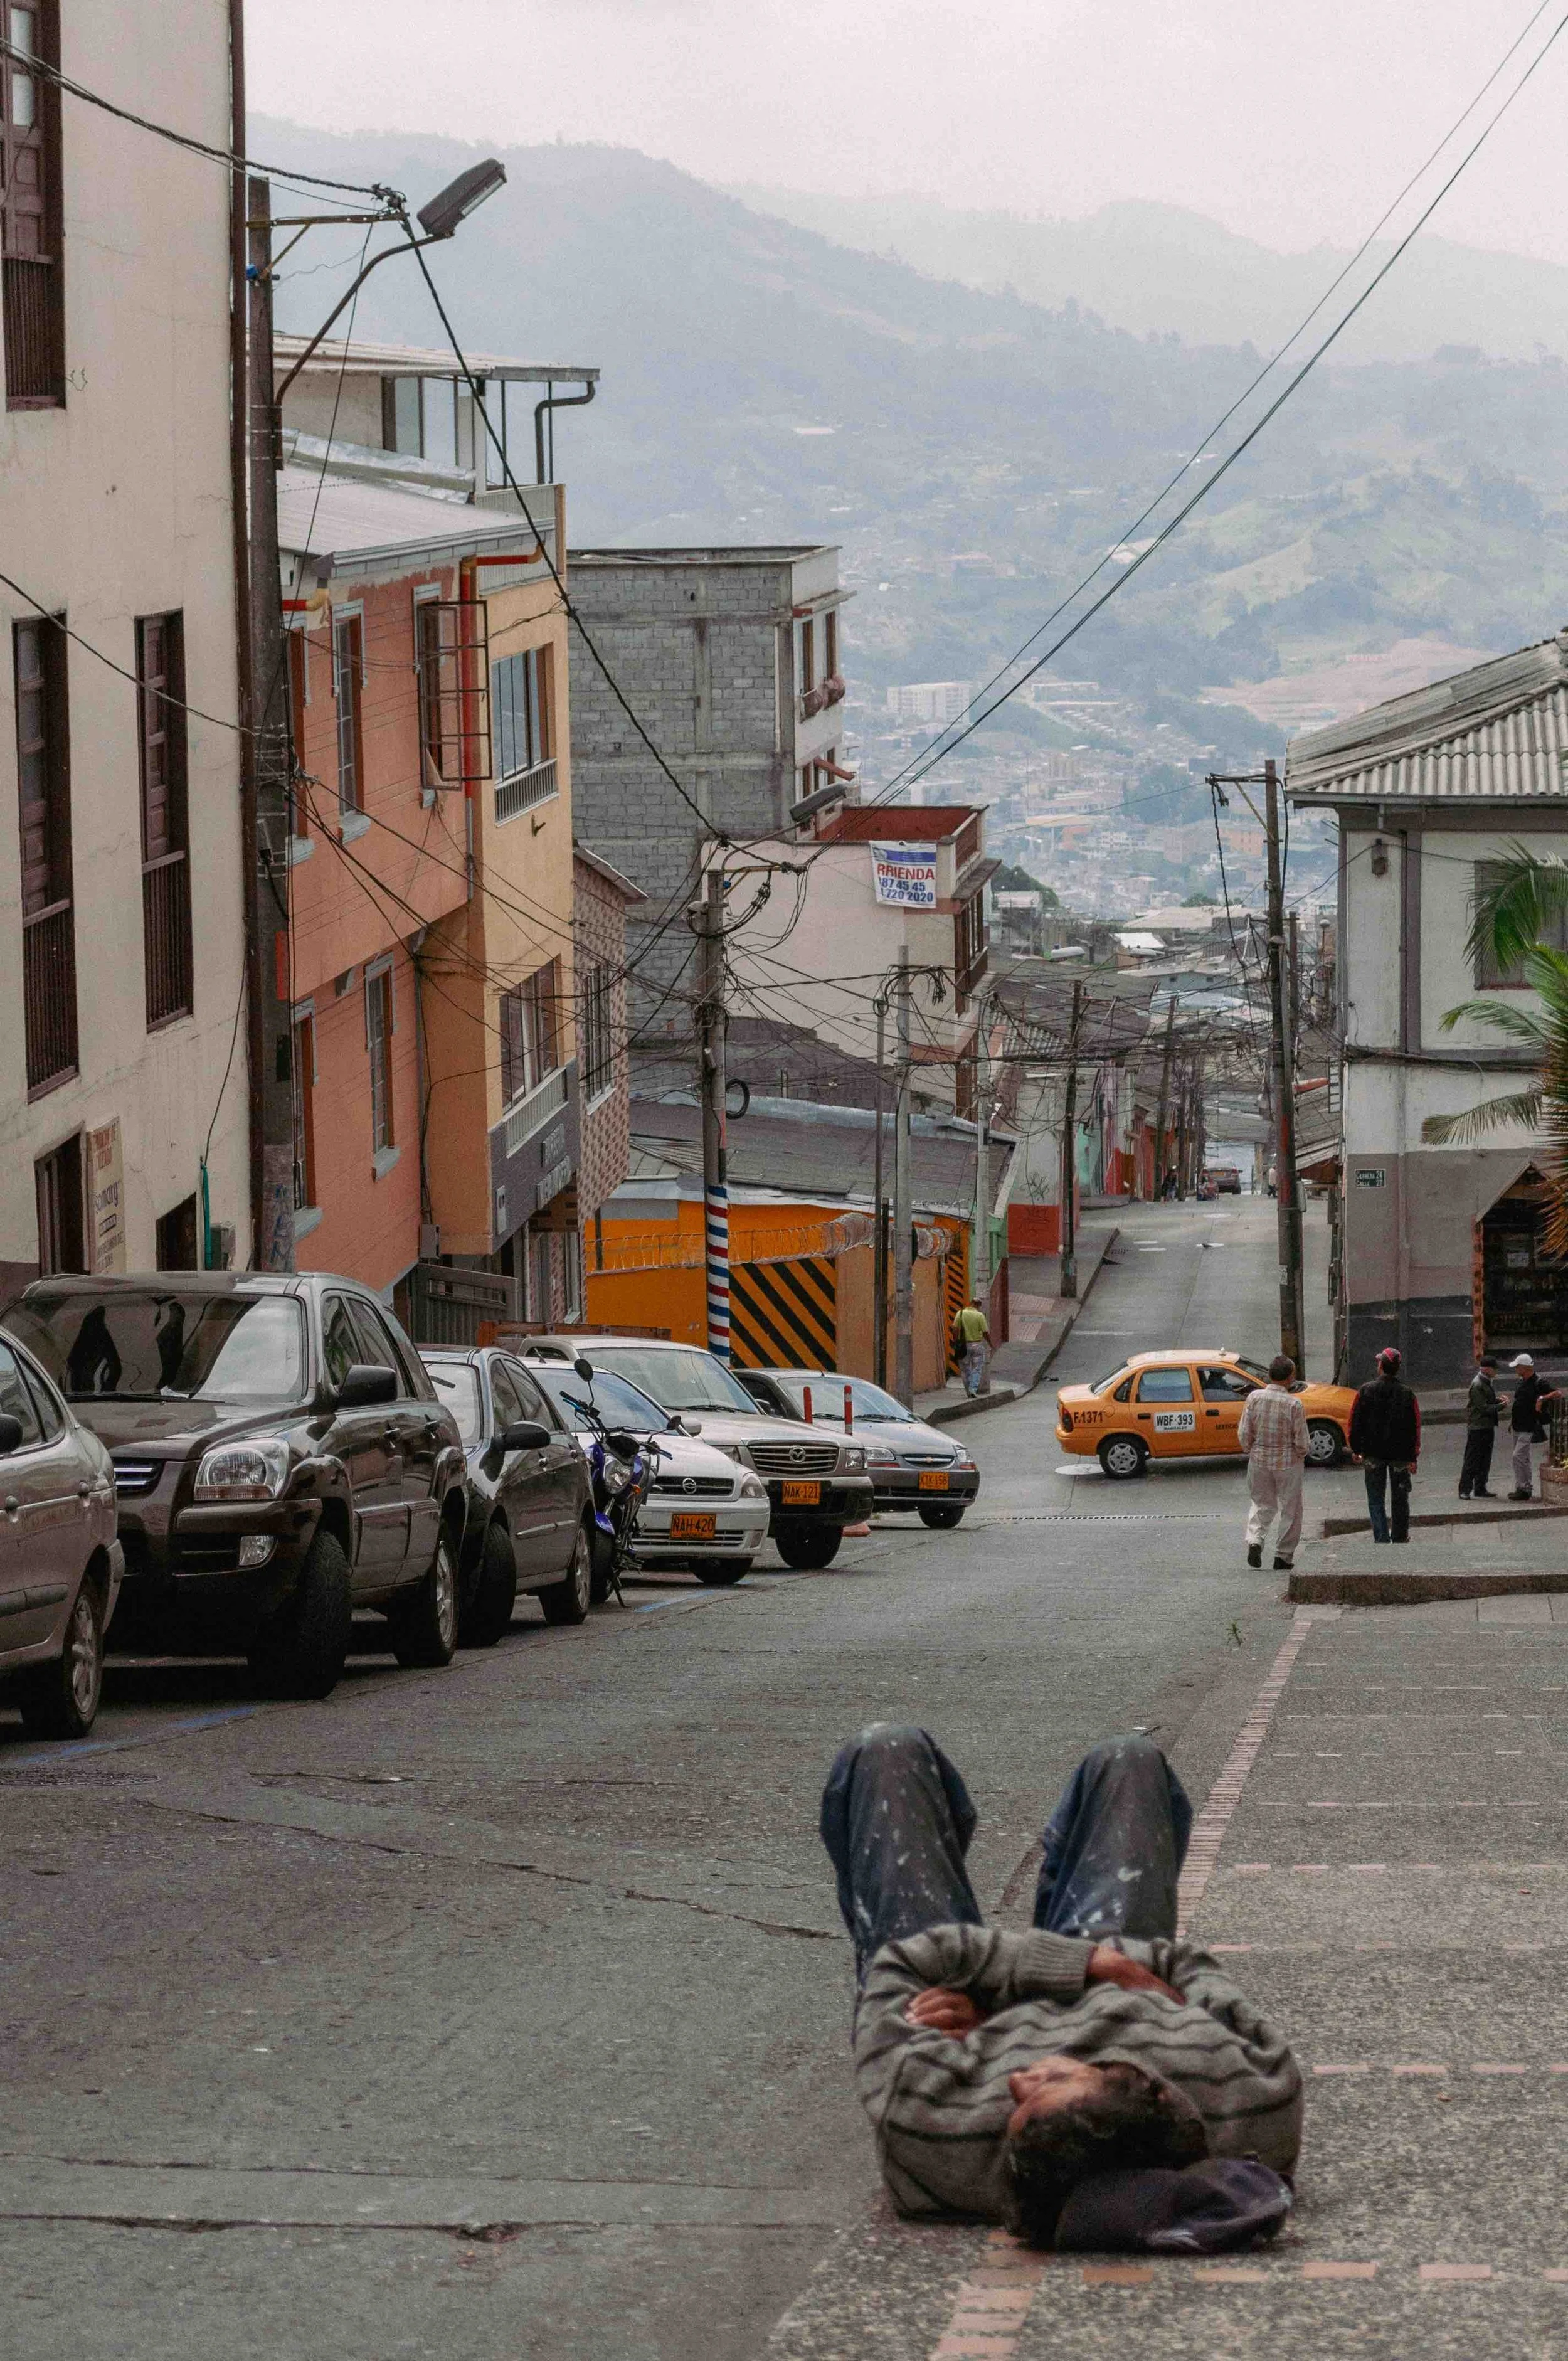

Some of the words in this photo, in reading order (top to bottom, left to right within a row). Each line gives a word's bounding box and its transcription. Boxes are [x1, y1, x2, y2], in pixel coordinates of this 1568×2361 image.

[896, 879, 909, 891] 45
[912, 881, 925, 892] 45
[907, 891, 933, 902] 2020
